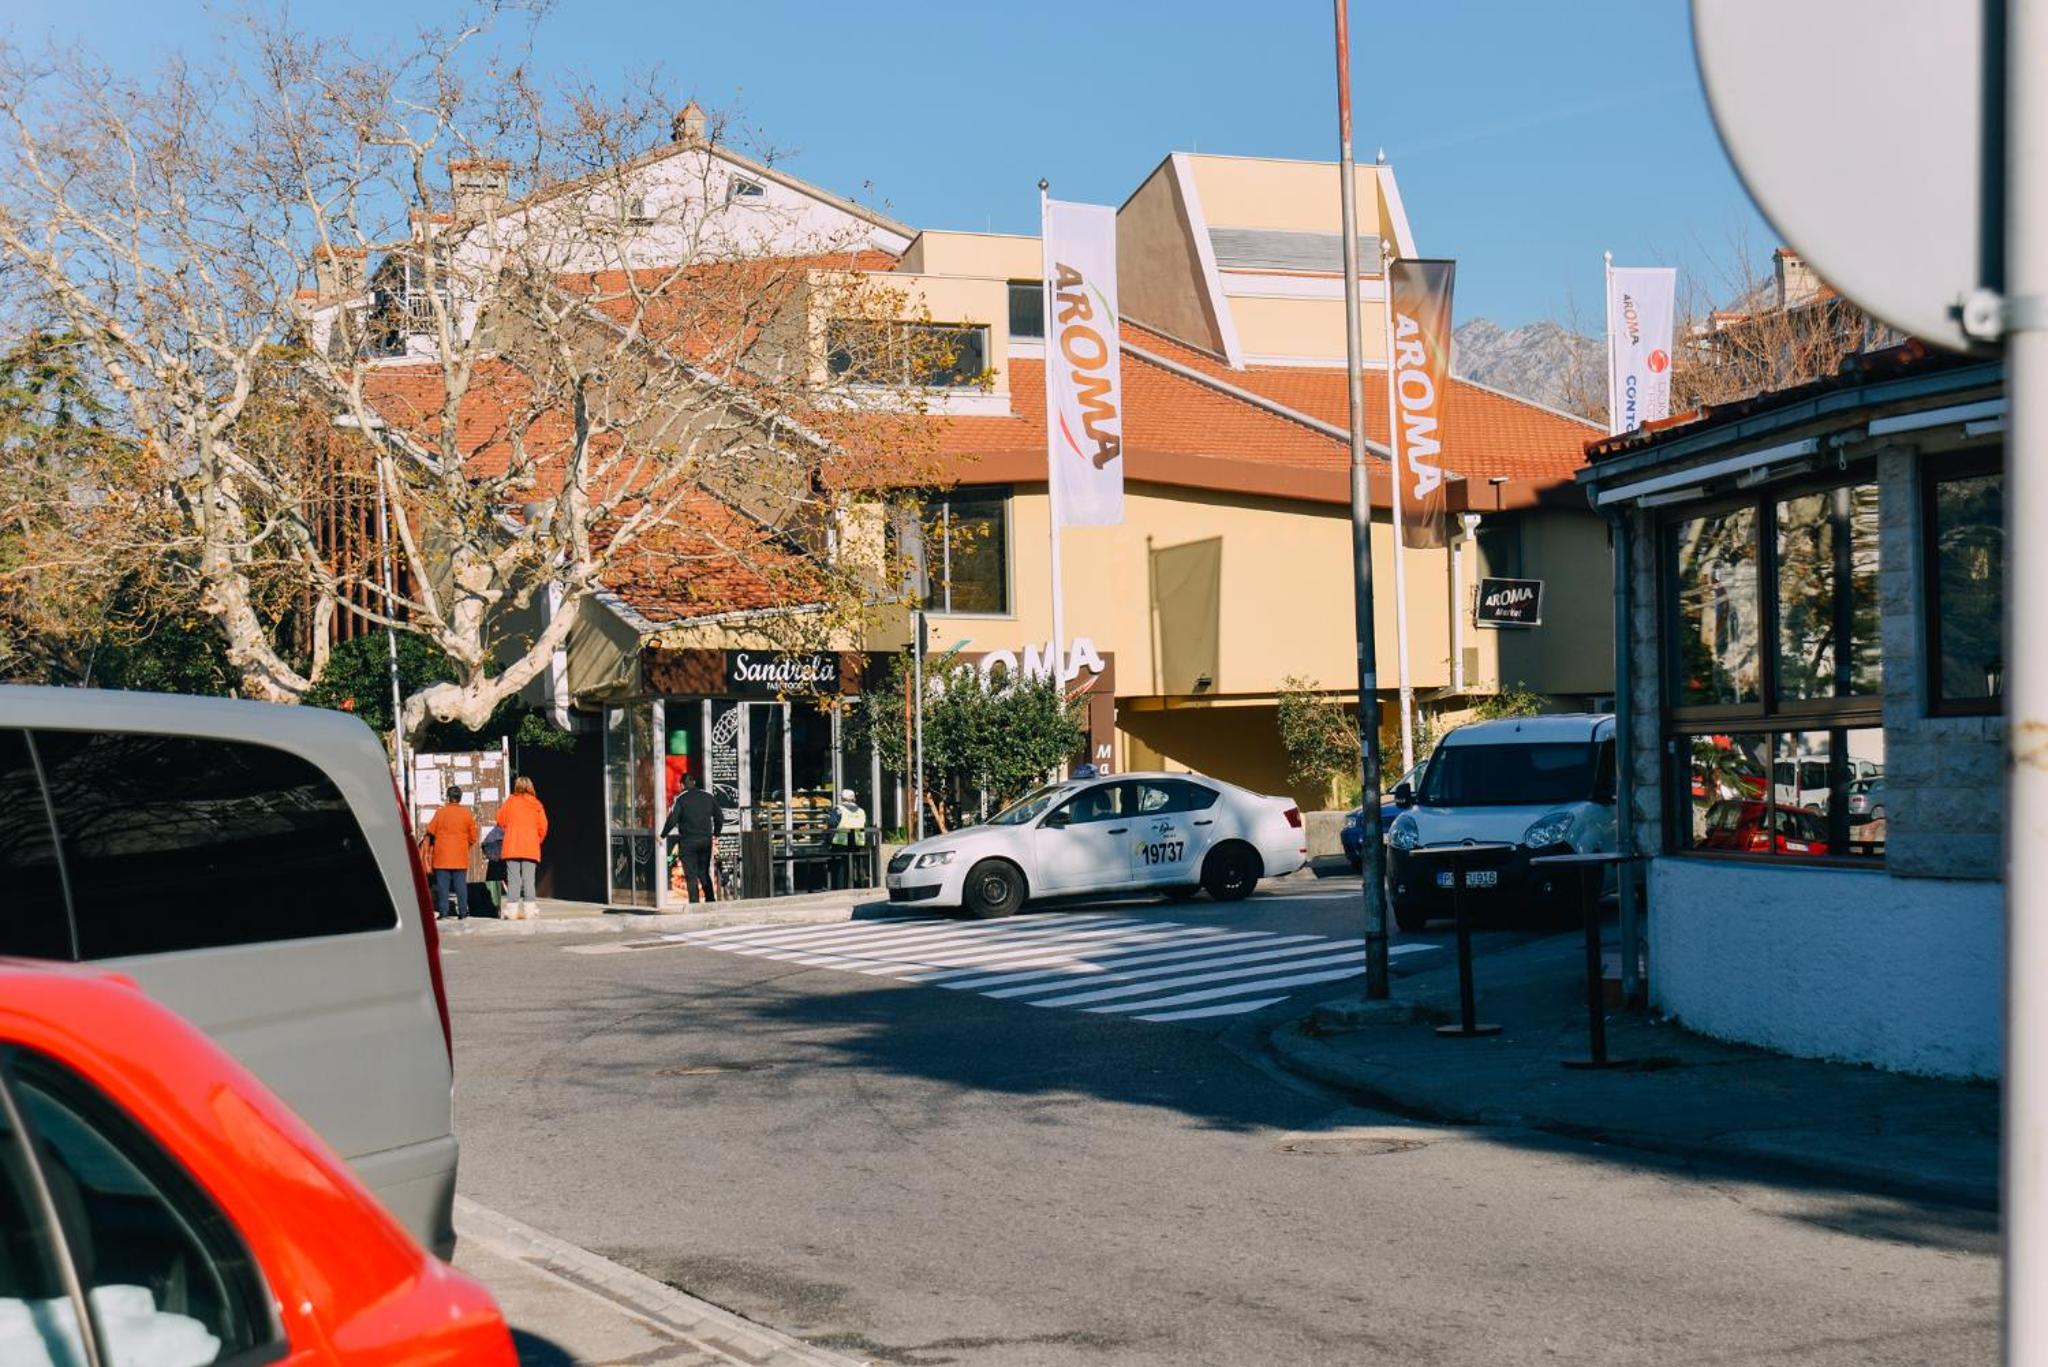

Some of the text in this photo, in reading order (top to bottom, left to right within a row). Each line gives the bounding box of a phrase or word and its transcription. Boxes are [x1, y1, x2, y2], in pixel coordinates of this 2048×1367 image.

[1624, 294, 1639, 346] AROMA
[1055, 262, 1120, 470] AROMA
[1396, 313, 1443, 501] AROMA
[1485, 588, 1534, 606] AROMA
[1142, 841, 1184, 865] 19737
